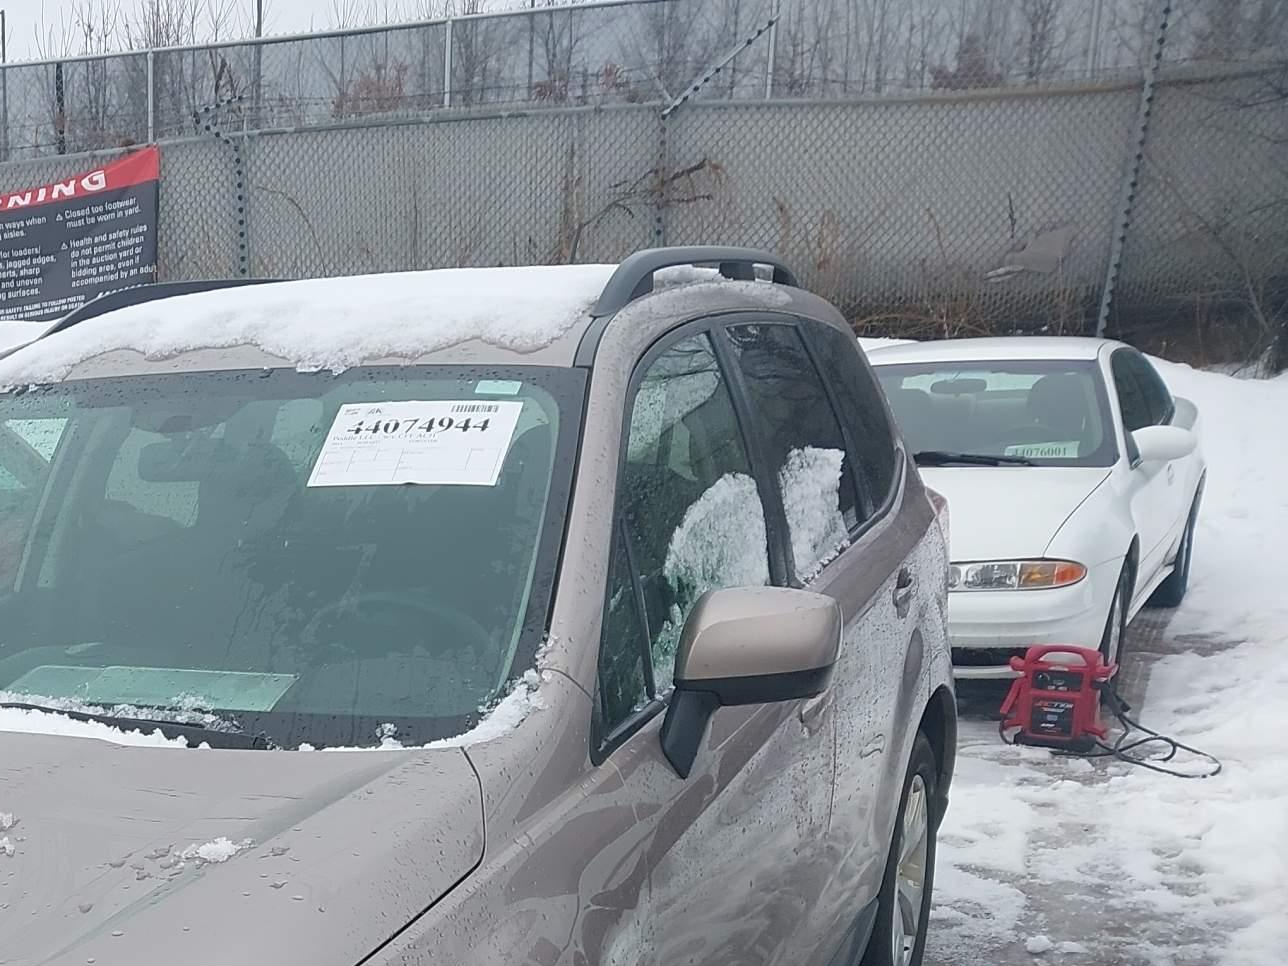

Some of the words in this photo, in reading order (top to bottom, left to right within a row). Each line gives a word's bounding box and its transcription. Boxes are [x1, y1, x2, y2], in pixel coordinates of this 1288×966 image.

[64, 206, 90, 218] Closed
[92, 204, 104, 213] toe
[105, 198, 136, 210] footwear
[66, 218, 85, 228] must
[86, 216, 96, 224] be
[96, 214, 116, 223] worn
[116, 210, 124, 218] in
[124, 204, 141, 217] yard.
[4, 220, 24, 230] ways
[26, 216, 47, 226] when
[4, 230, 26, 240] aisles.
[69, 236, 93, 248] Health
[94, 232, 107, 242] and
[108, 229, 130, 241] safety
[130, 224, 148, 235] rules
[0, 250, 10, 259] for
[70, 248, 80, 258] do
[81, 246, 92, 256] not
[94, 242, 116, 256] permit
[117, 236, 144, 248] children
[6, 257, 31, 270] jagged
[32, 254, 56, 265] edges,
[70, 258, 78, 268] in
[79, 256, 90, 267] the
[92, 252, 118, 264] auction
[118, 248, 134, 260] yard
[134, 246, 142, 254] or
[19, 266, 40, 276] sharp
[71, 266, 98, 278] bidding
[98, 262, 116, 273] area,
[118, 259, 134, 269] even
[134, 255, 140, 264] if
[1, 280, 14, 288] and
[16, 276, 42, 287] uneven
[71, 270, 118, 288] accompanied
[120, 269, 128, 279] by
[129, 268, 138, 276] an
[8, 287, 40, 298] surfaces.
[347, 416, 490, 434] 44074944
